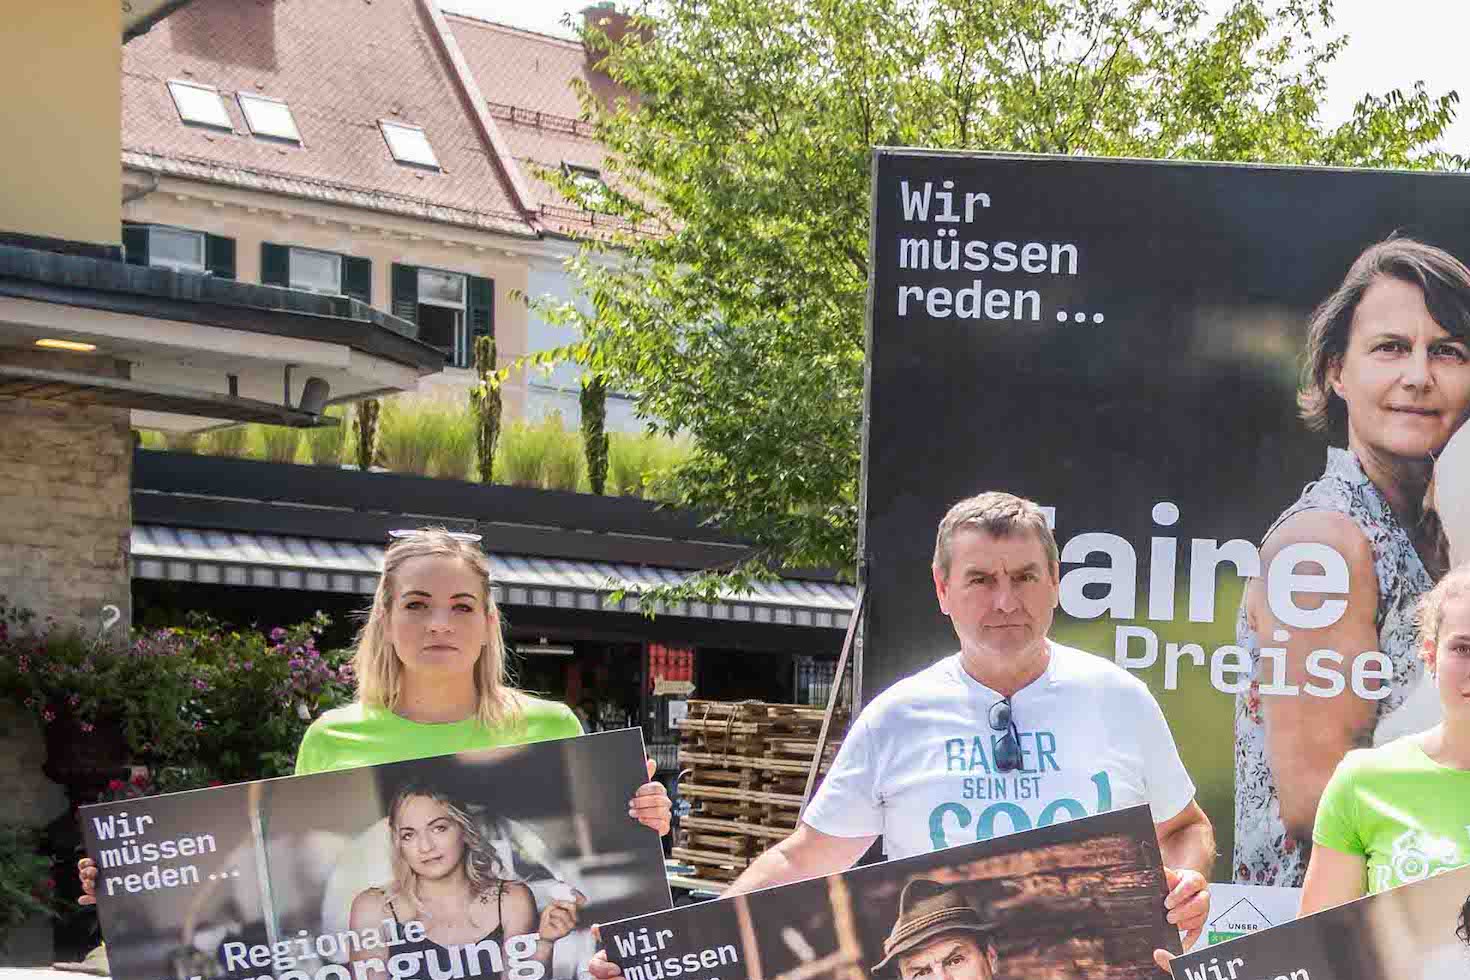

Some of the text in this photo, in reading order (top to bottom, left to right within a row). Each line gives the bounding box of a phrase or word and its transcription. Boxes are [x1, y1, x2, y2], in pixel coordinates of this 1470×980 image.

[901, 181, 991, 224] Wir
[899, 229, 1078, 275] müssen
[898, 279, 1041, 321] reden
[1046, 502, 1349, 628] aire
[1113, 626, 1393, 700] Preise
[962, 776, 1041, 800] SEIN IST
[93, 811, 154, 840] Wir
[100, 833, 217, 869] müssen
[105, 864, 200, 897] reden
[224, 918, 427, 972] Regionale
[614, 927, 674, 958] Wir
[1228, 923, 1258, 931] UNSER
